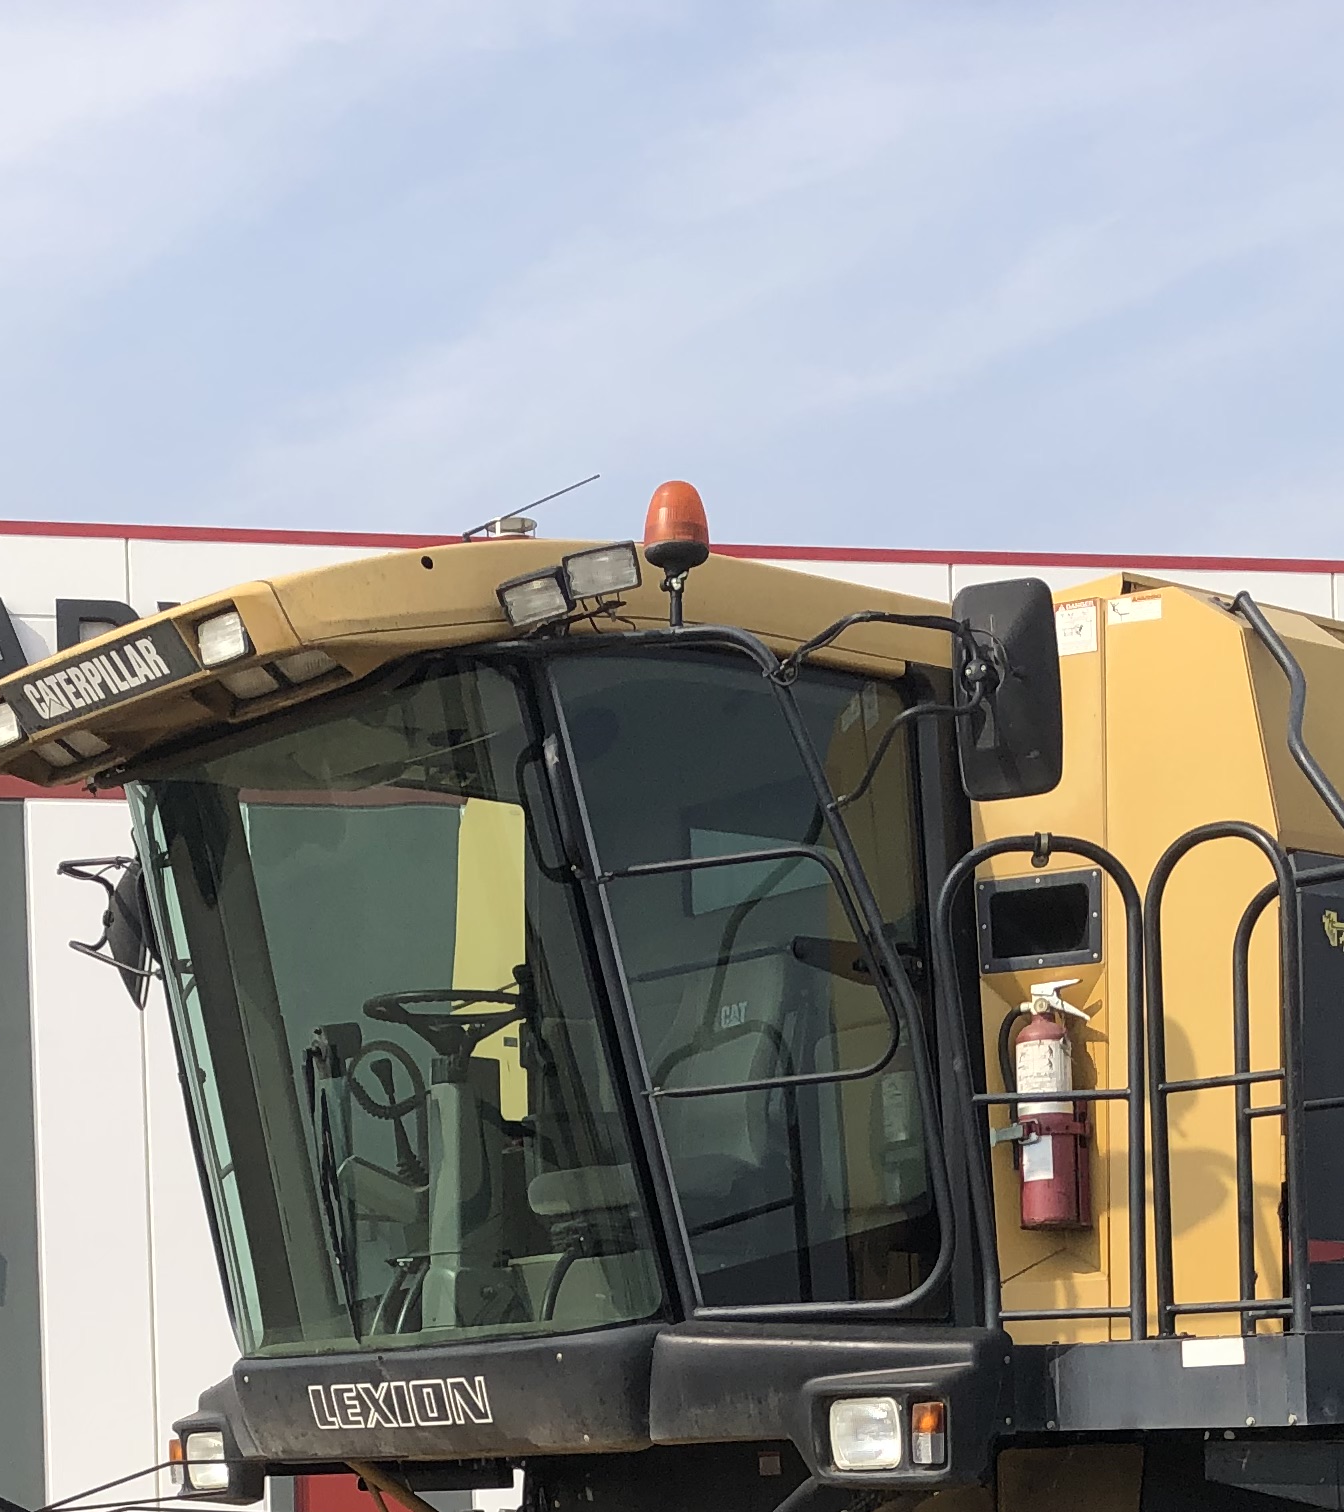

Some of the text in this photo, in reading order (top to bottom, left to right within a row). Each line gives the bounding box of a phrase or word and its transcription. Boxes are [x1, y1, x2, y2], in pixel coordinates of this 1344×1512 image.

[23, 637, 171, 720] CATERPILLAR
[720, 1001, 748, 1028] CAT
[307, 1375, 494, 1430] LEXION
